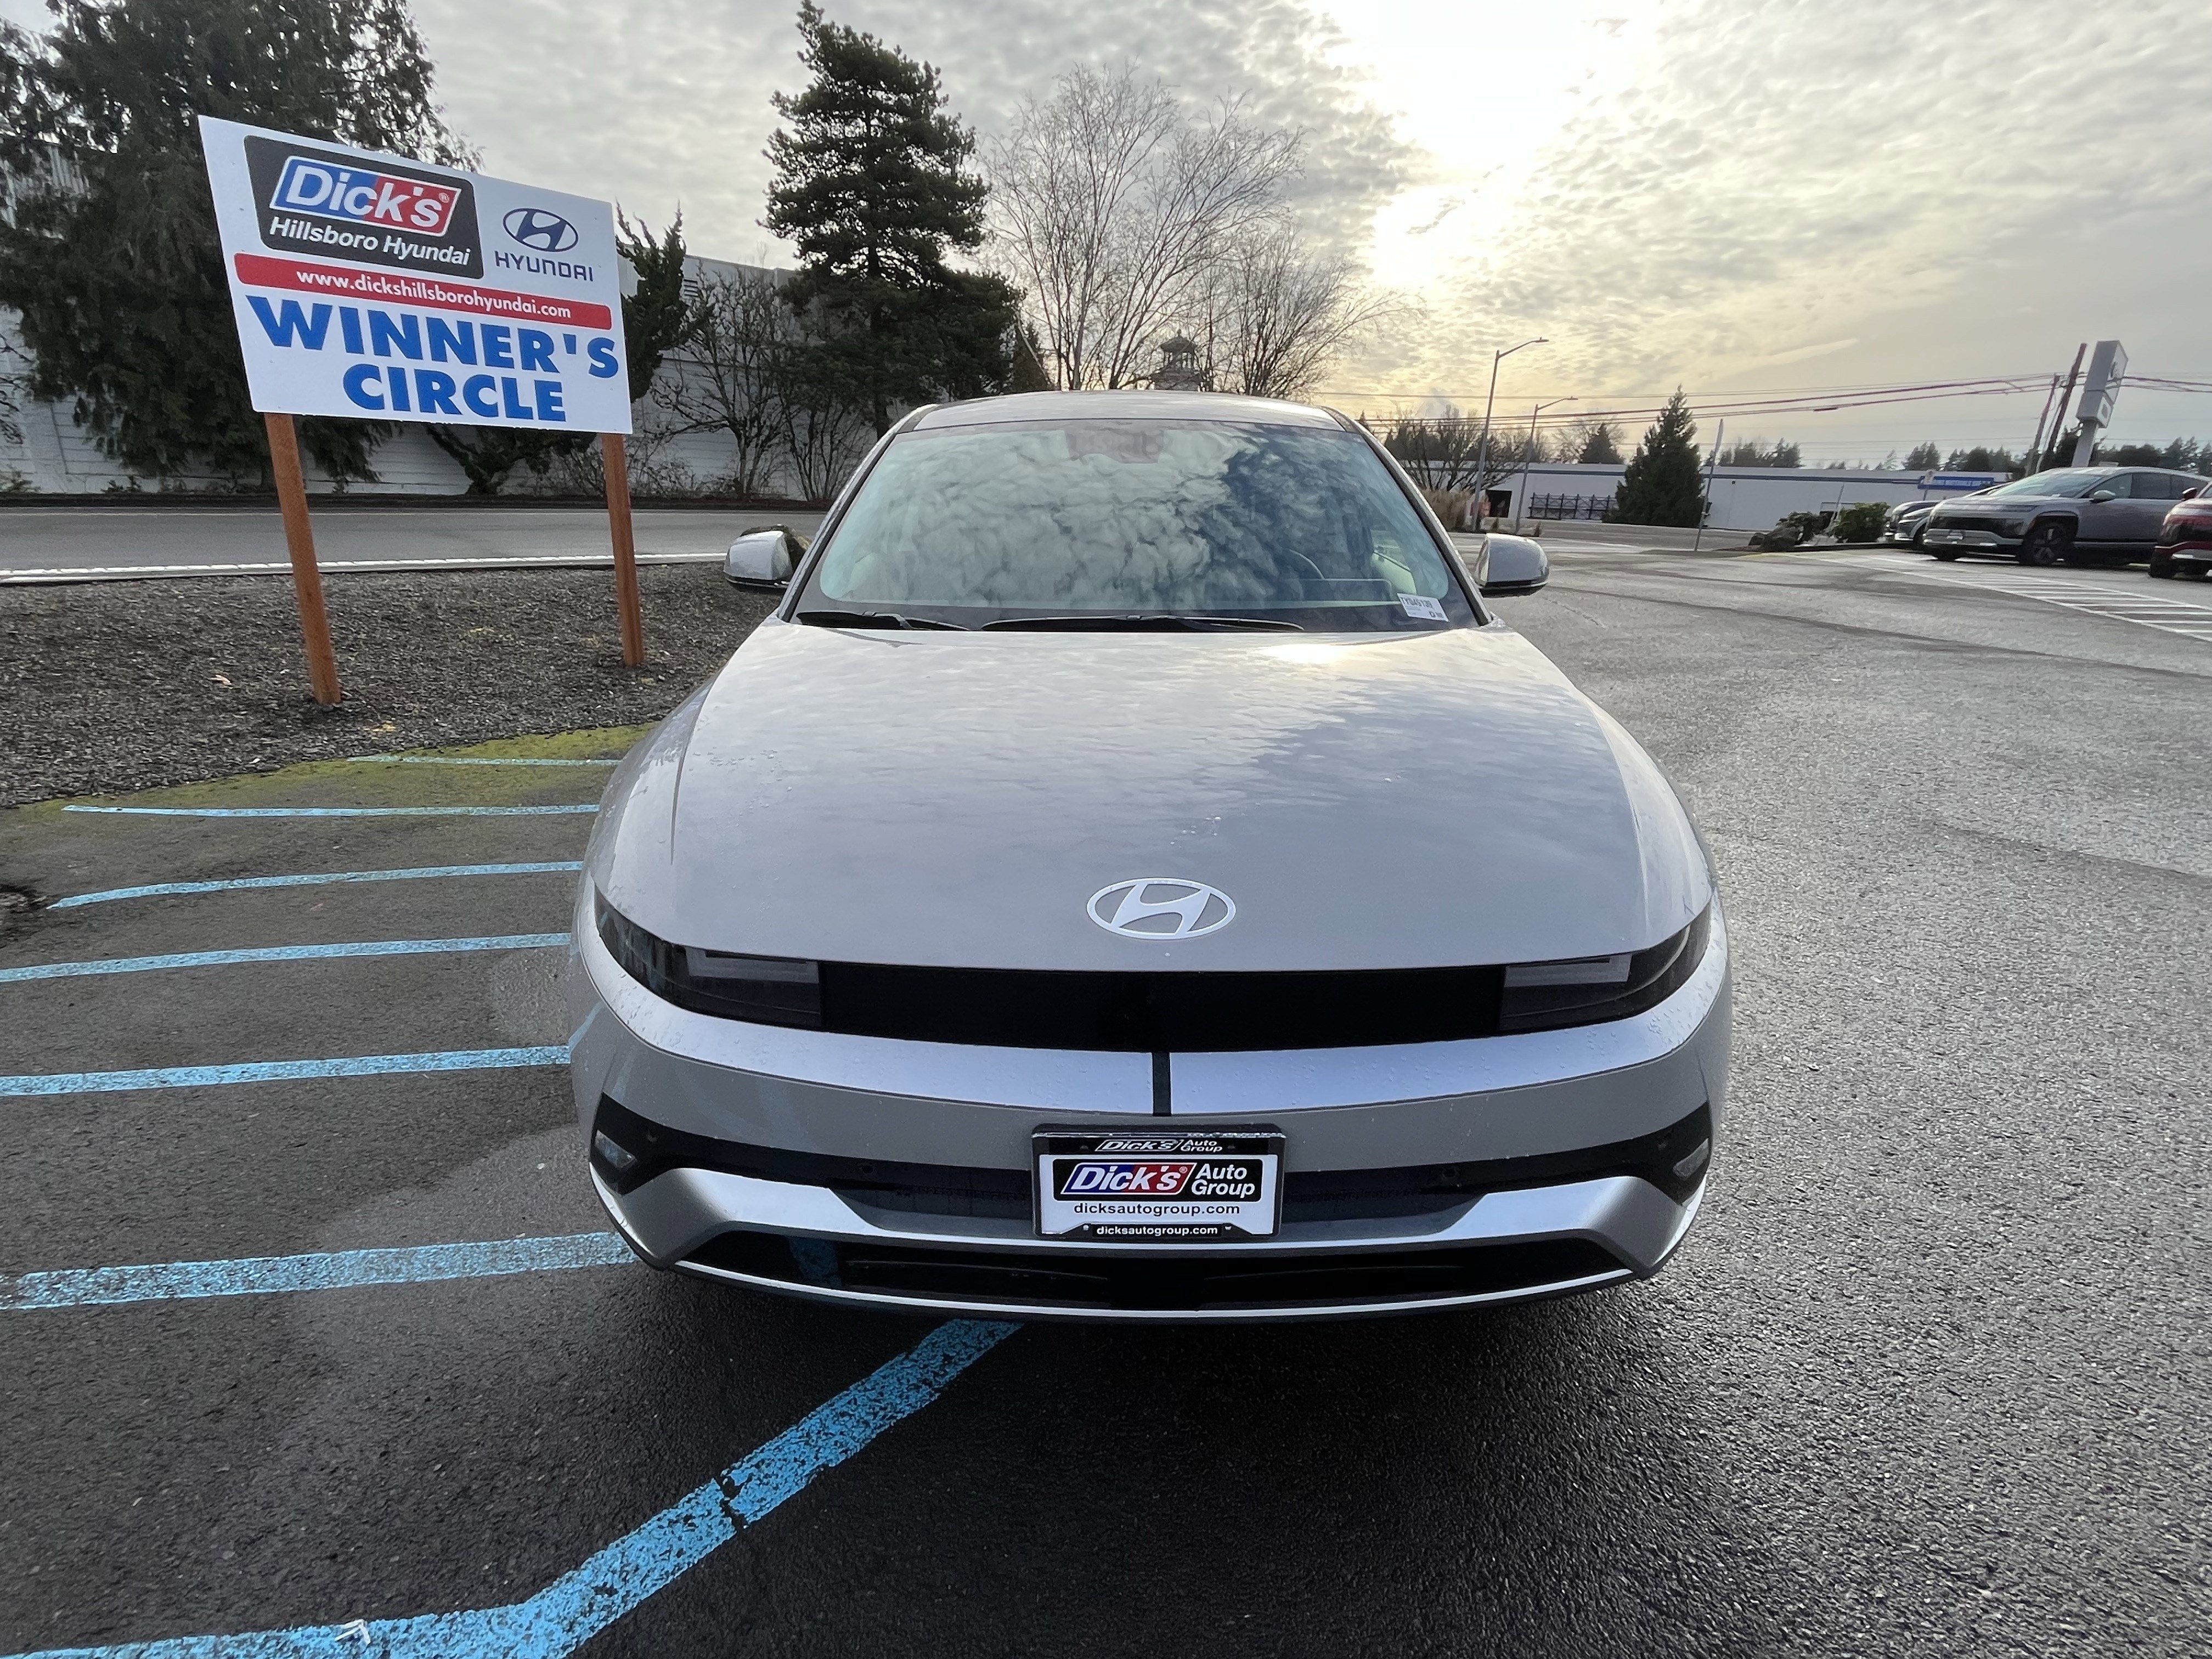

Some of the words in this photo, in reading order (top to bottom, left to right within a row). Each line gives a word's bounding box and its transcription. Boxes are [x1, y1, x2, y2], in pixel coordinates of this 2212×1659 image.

[269, 216, 379, 251] Hillsboro
[383, 235, 471, 266] Hyundai
[495, 250, 594, 282] HYUNDAI
[296, 269, 571, 319] www.dickshillsborohyundai.com
[246, 295, 618, 379] WINNER'S
[343, 363, 567, 422] CIRCLE
[1194, 1164, 1247, 1180] Auto
[1191, 1180, 1255, 1199] Group
[1074, 1203, 1240, 1217] dicksautogroup.com
[1096, 1226, 1218, 1237] dicksautogroup.com
